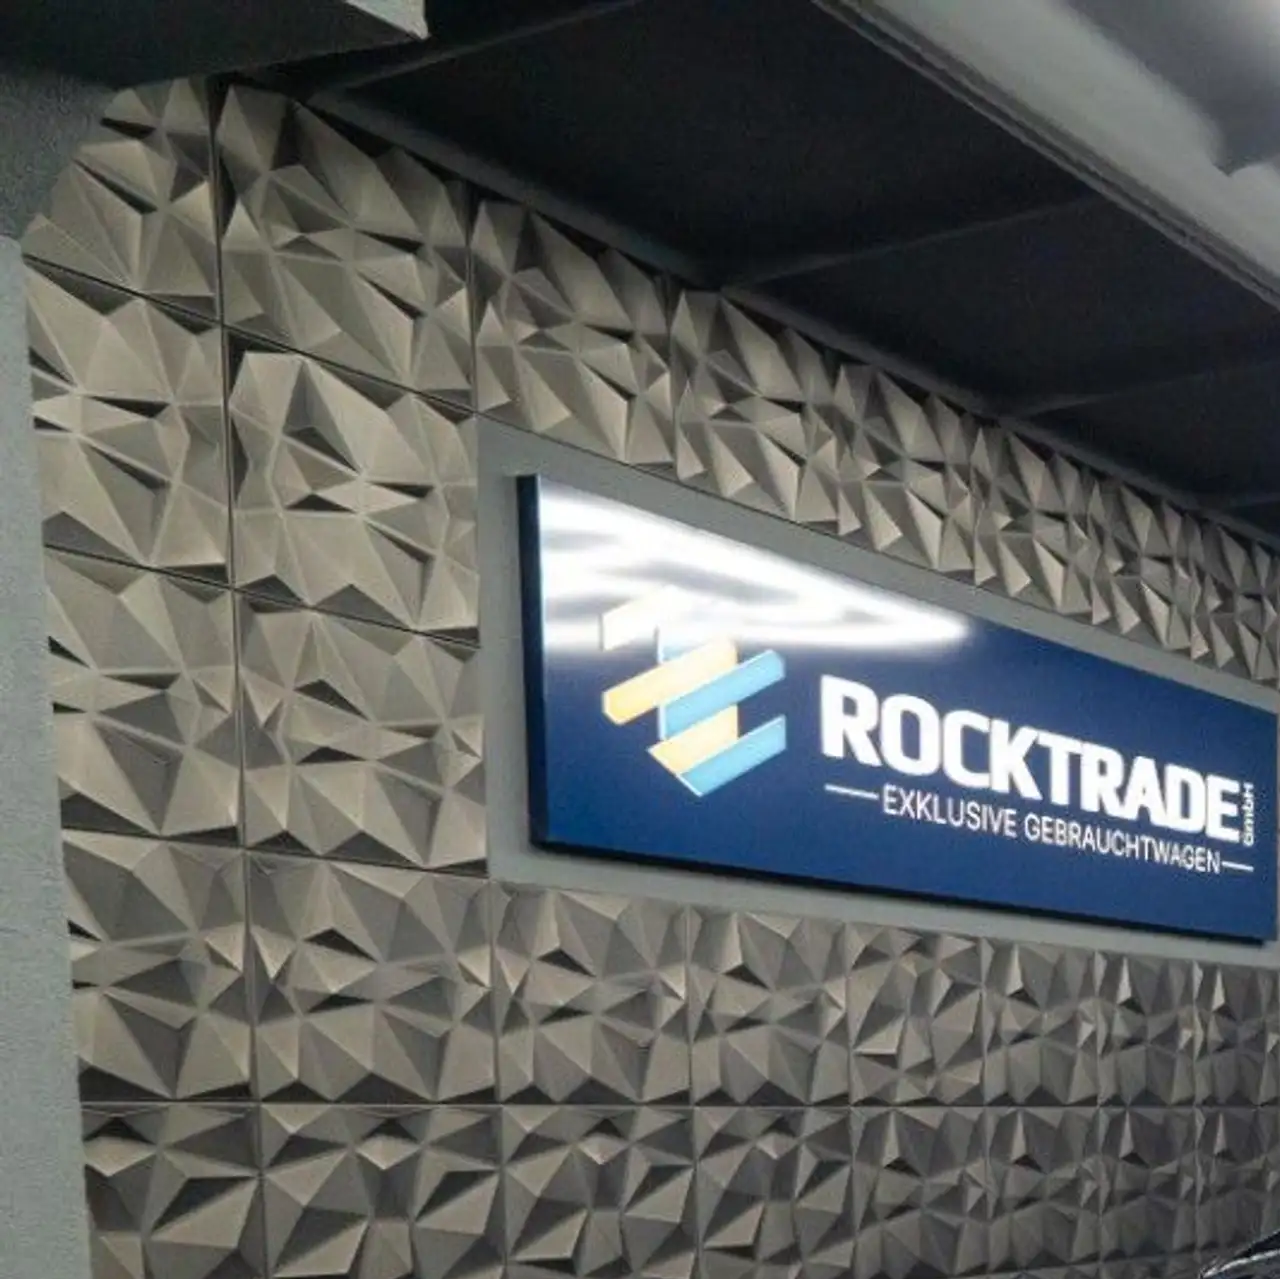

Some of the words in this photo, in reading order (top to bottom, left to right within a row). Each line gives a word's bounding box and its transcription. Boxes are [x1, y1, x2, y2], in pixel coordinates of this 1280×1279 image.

[820, 674, 1240, 843] ROCKTRADE
[882, 783, 1018, 838] EXKLUSIVE
[1024, 812, 1221, 874] GEBRAUCHTWAGEN
